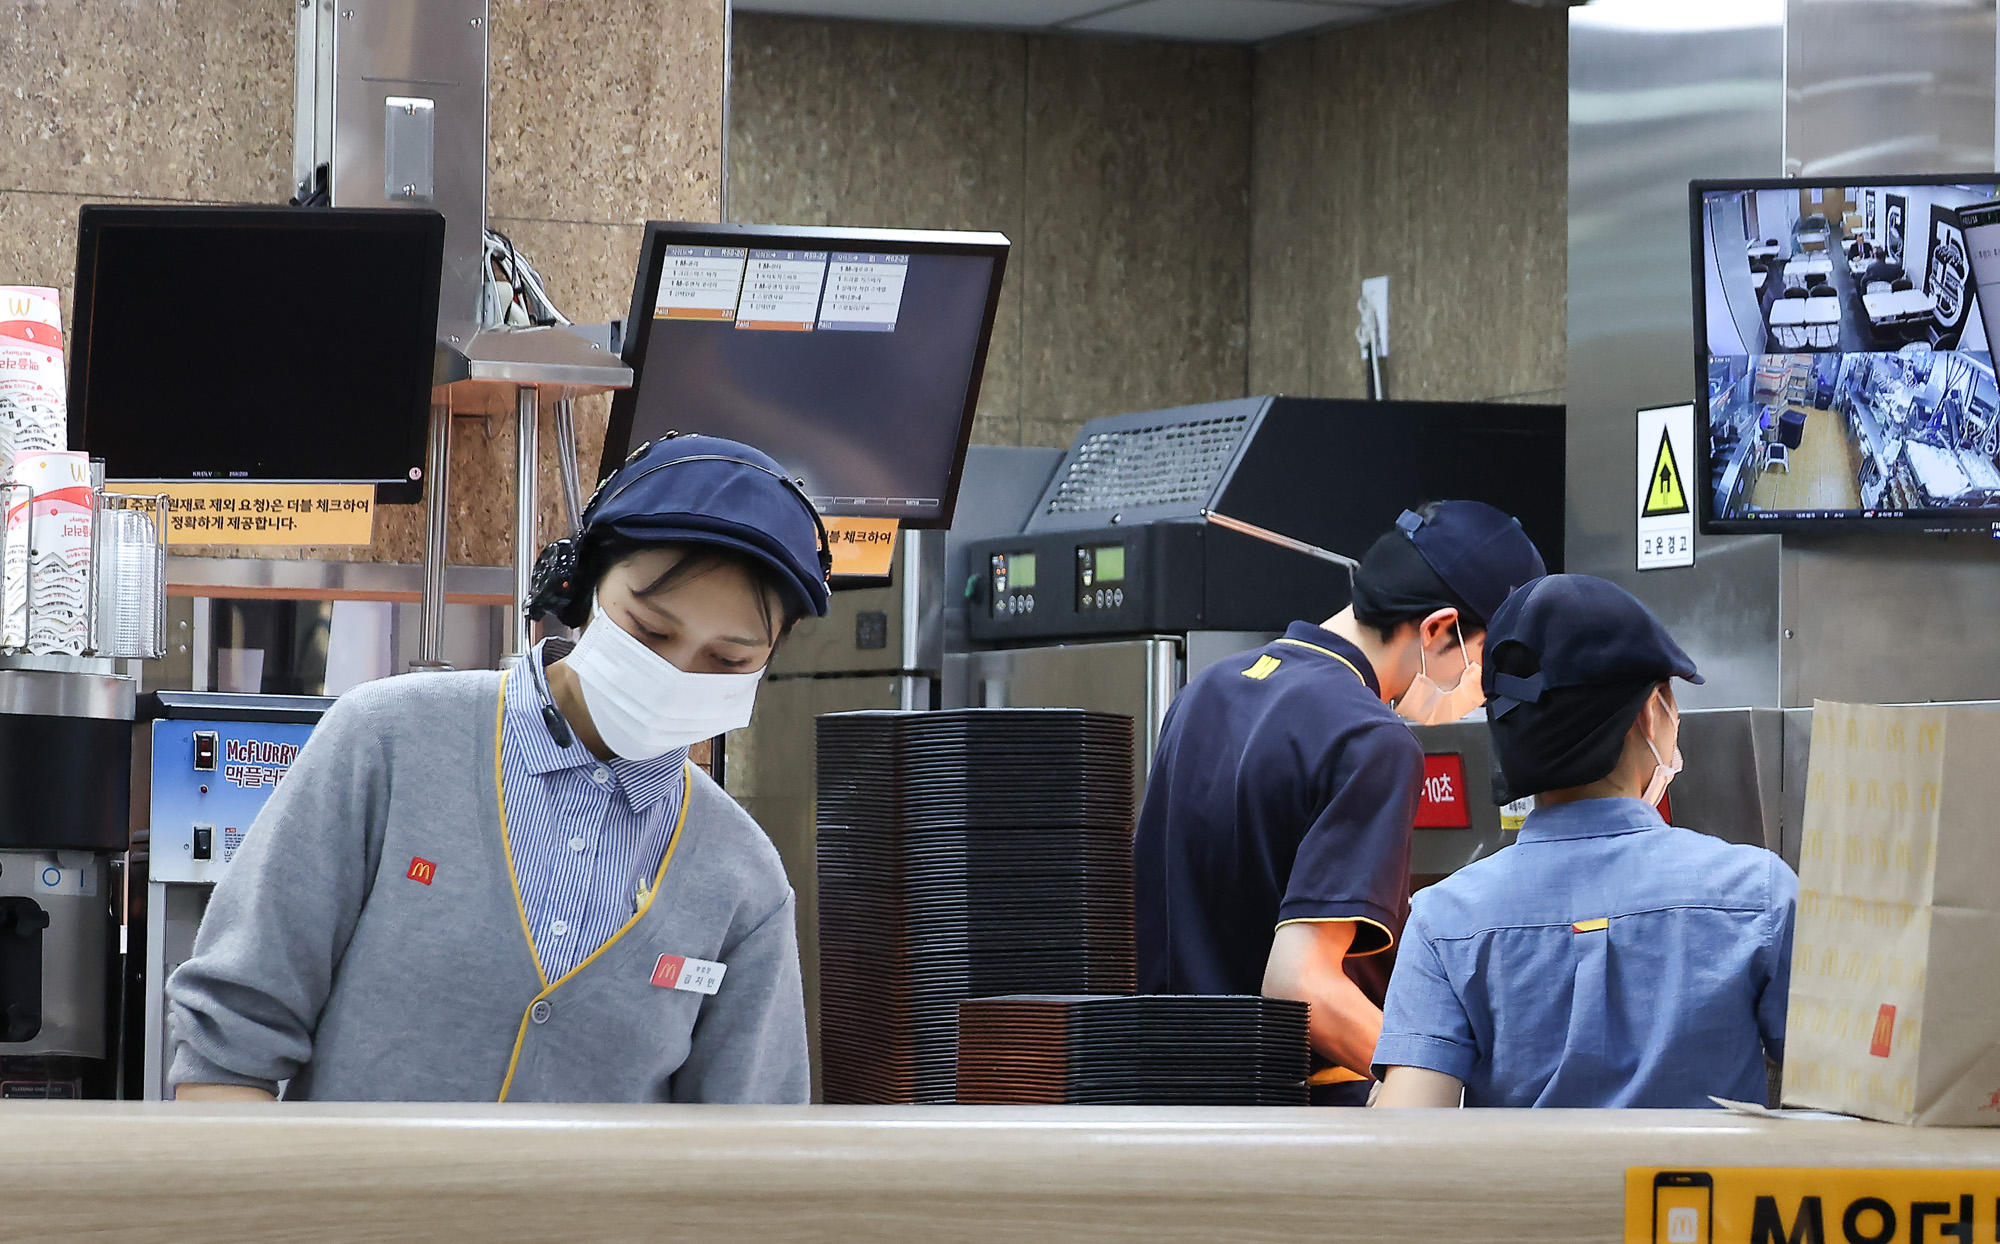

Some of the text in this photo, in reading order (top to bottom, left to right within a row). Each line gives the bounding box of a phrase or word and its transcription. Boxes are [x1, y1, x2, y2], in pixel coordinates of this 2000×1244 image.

[209, 498, 236, 513] 제외
[287, 498, 313, 513] 더블
[316, 498, 370, 513] 체크하여
[62, 524, 91, 537] 플러리
[171, 516, 298, 531] 정확하게 제공합니다.
[843, 530, 892, 544] 체크하여
